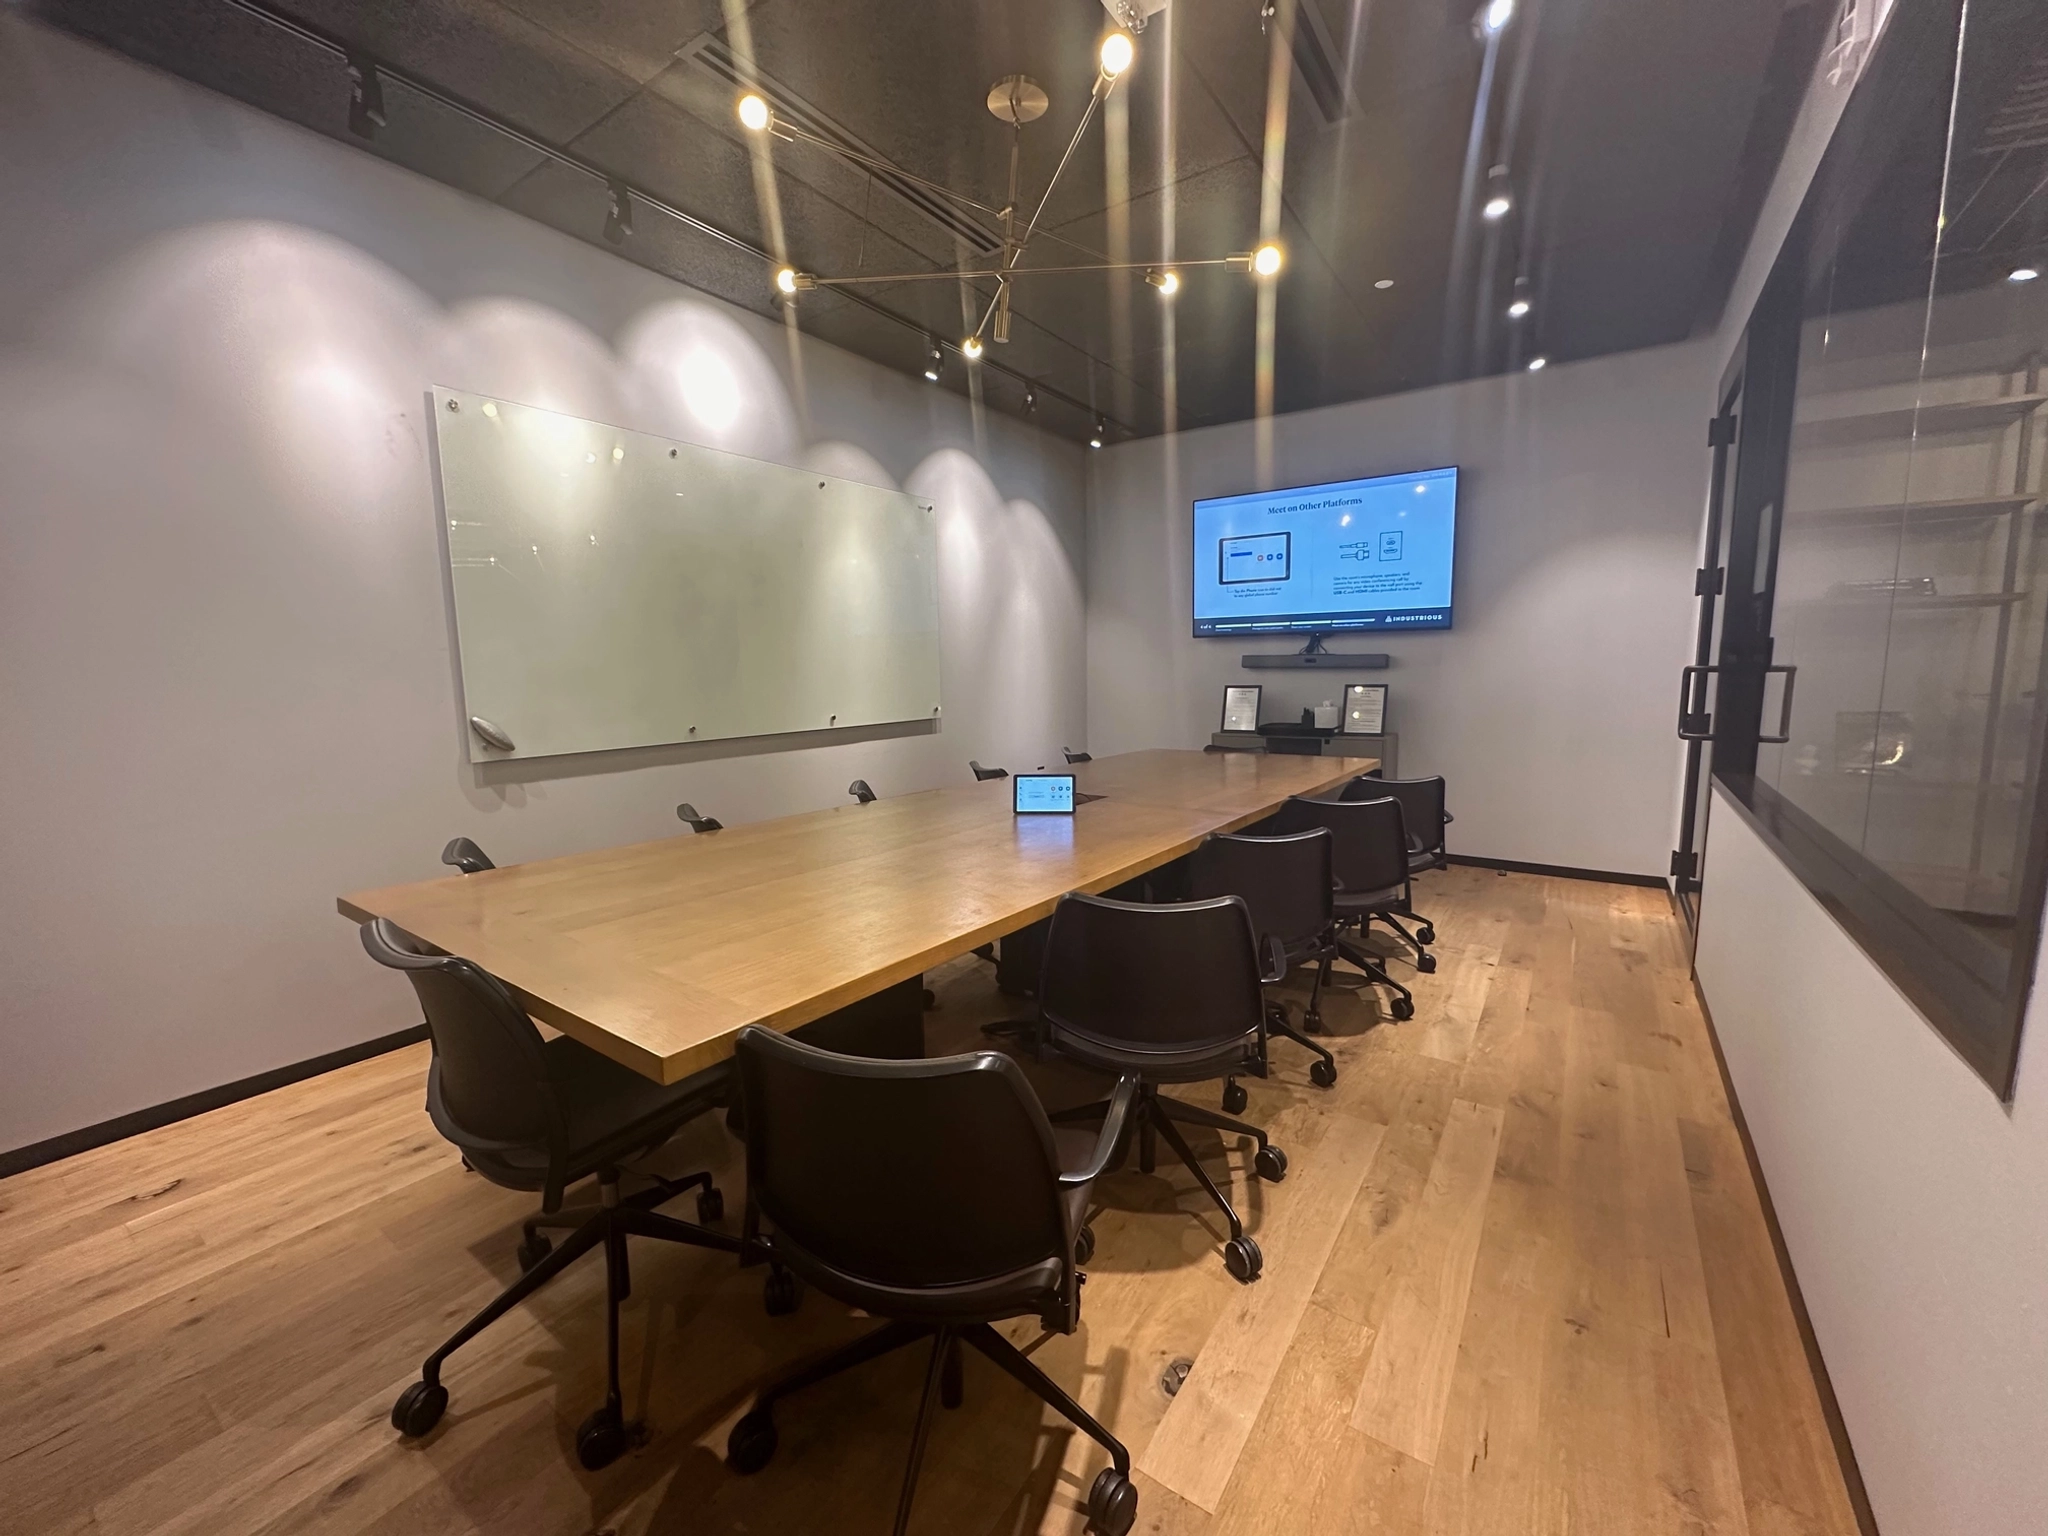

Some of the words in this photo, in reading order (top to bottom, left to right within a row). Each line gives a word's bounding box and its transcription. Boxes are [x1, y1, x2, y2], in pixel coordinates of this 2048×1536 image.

[1267, 506, 1286, 514] Meet
[1299, 502, 1321, 511] Other
[1323, 498, 1363, 508] Platforms
